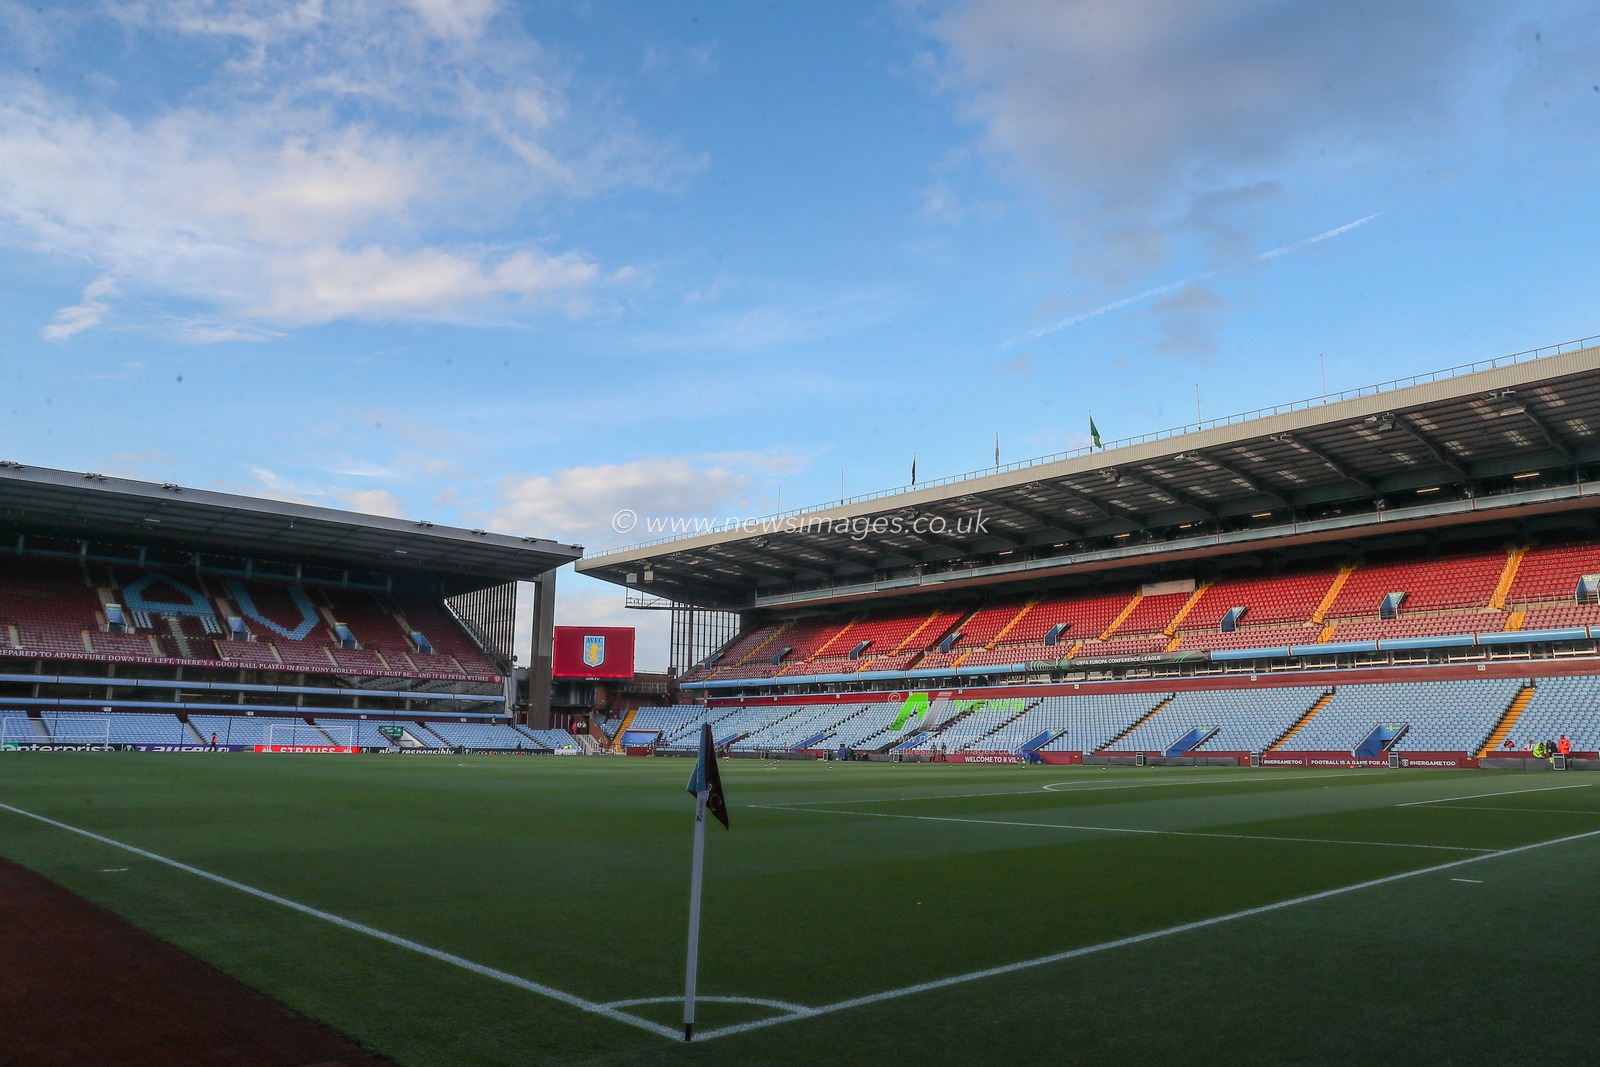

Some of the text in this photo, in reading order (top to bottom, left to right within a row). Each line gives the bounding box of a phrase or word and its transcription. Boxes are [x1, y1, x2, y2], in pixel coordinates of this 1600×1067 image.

[53, 651, 106, 661] ADVENTURE
[107, 654, 135, 662] DOWN
[154, 657, 174, 665] LEFT,
[176, 658, 208, 666] THERE'S
[216, 660, 238, 668] GOOD
[1076, 655, 1162, 667] UEFA EUROPA CONFERENCE LEAGUE
